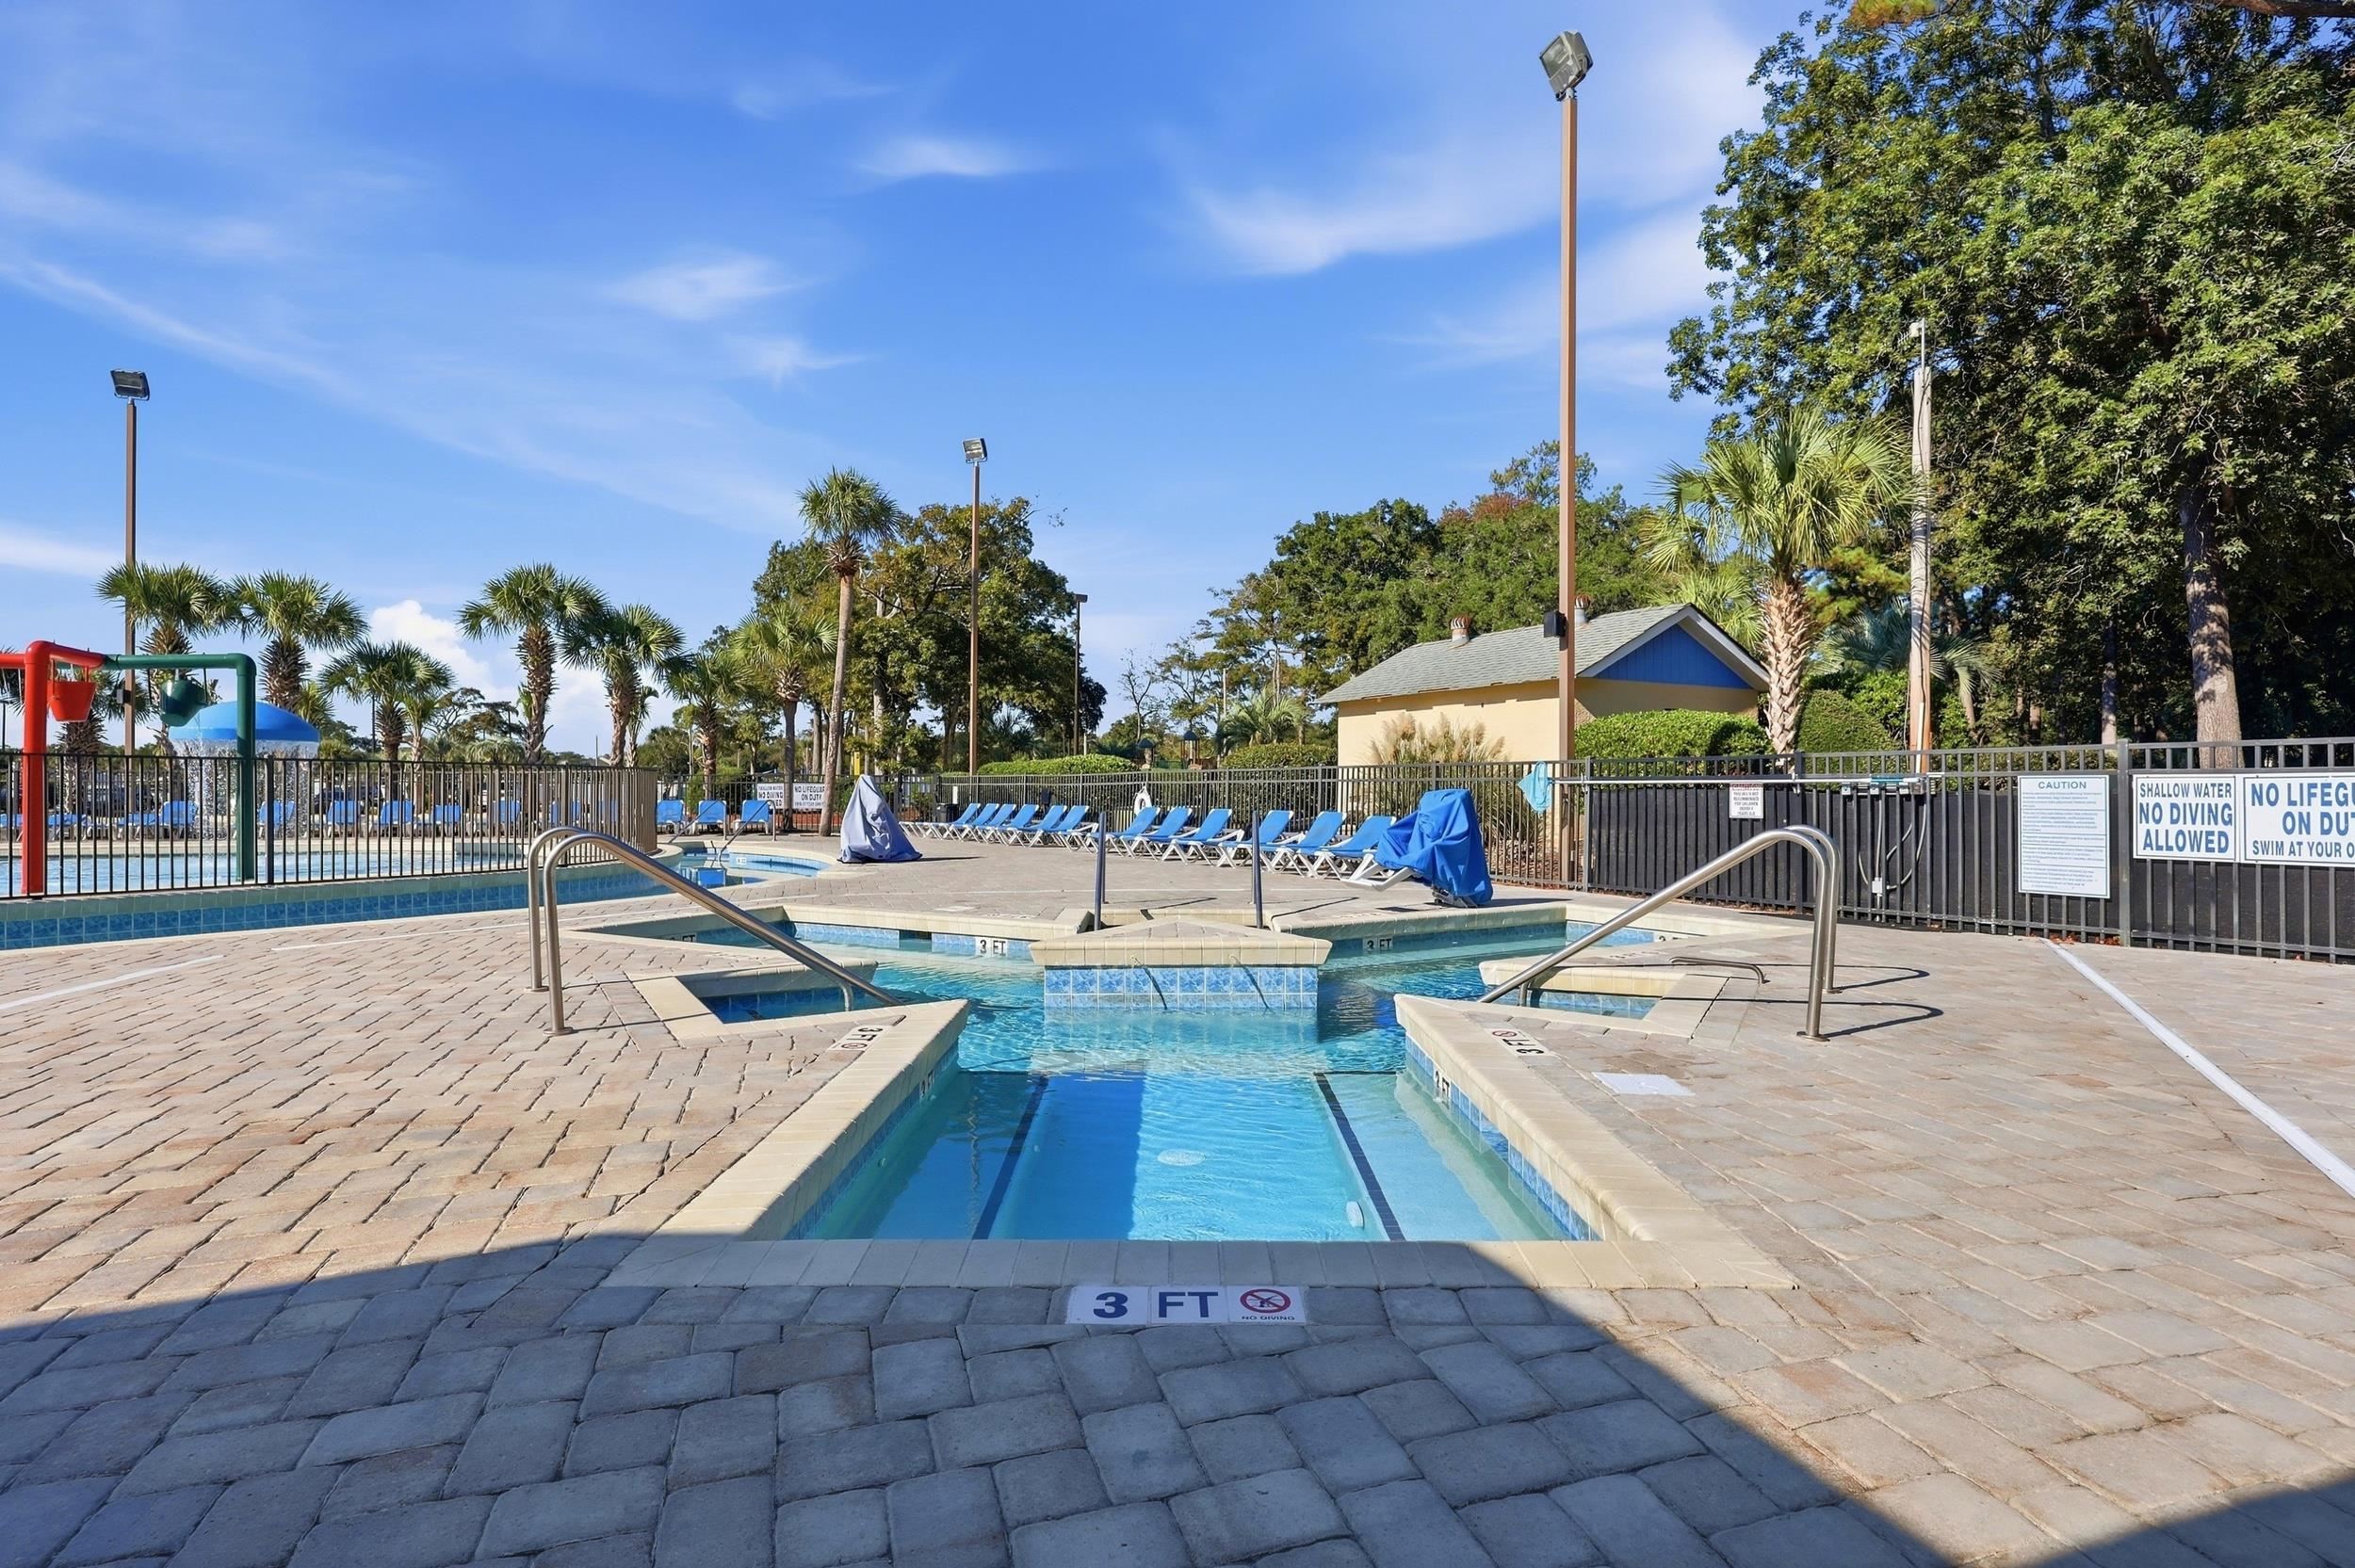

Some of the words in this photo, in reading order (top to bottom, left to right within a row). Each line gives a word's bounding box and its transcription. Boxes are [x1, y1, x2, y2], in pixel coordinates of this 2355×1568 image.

[2038, 781, 2087, 789] CAUTION
[2140, 783, 2190, 798] SHALLOW
[2194, 783, 2232, 798] WATER
[2250, 783, 2279, 807] NO
[2287, 782, 2355, 807] LIFEG
[2139, 801, 2163, 825] NO
[2169, 802, 2233, 826] DIVING
[2282, 811, 2311, 835] ON
[2143, 828, 2230, 853] ALLOWED
[2252, 839, 2284, 856] SWIM
[2288, 841, 2304, 856] AT
[2307, 841, 2343, 858] YOUR
[1093, 1291, 1129, 1318] 3
[1158, 1291, 1219, 1318] FT
